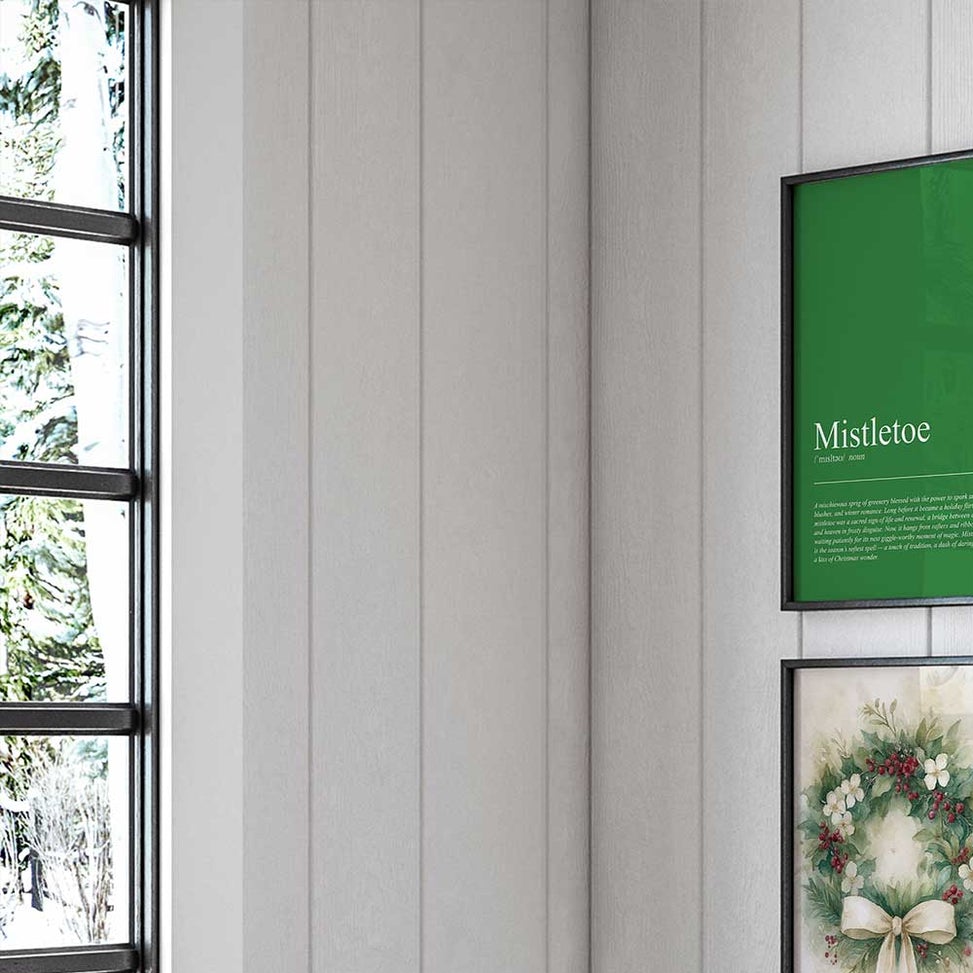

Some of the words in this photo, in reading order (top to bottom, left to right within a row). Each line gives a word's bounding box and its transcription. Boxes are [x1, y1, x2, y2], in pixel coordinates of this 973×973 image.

[814, 417, 931, 450] Mistletoe
[953, 493, 968, 501] spark
[944, 503, 963, 511] holiday
[854, 536, 862, 544] for
